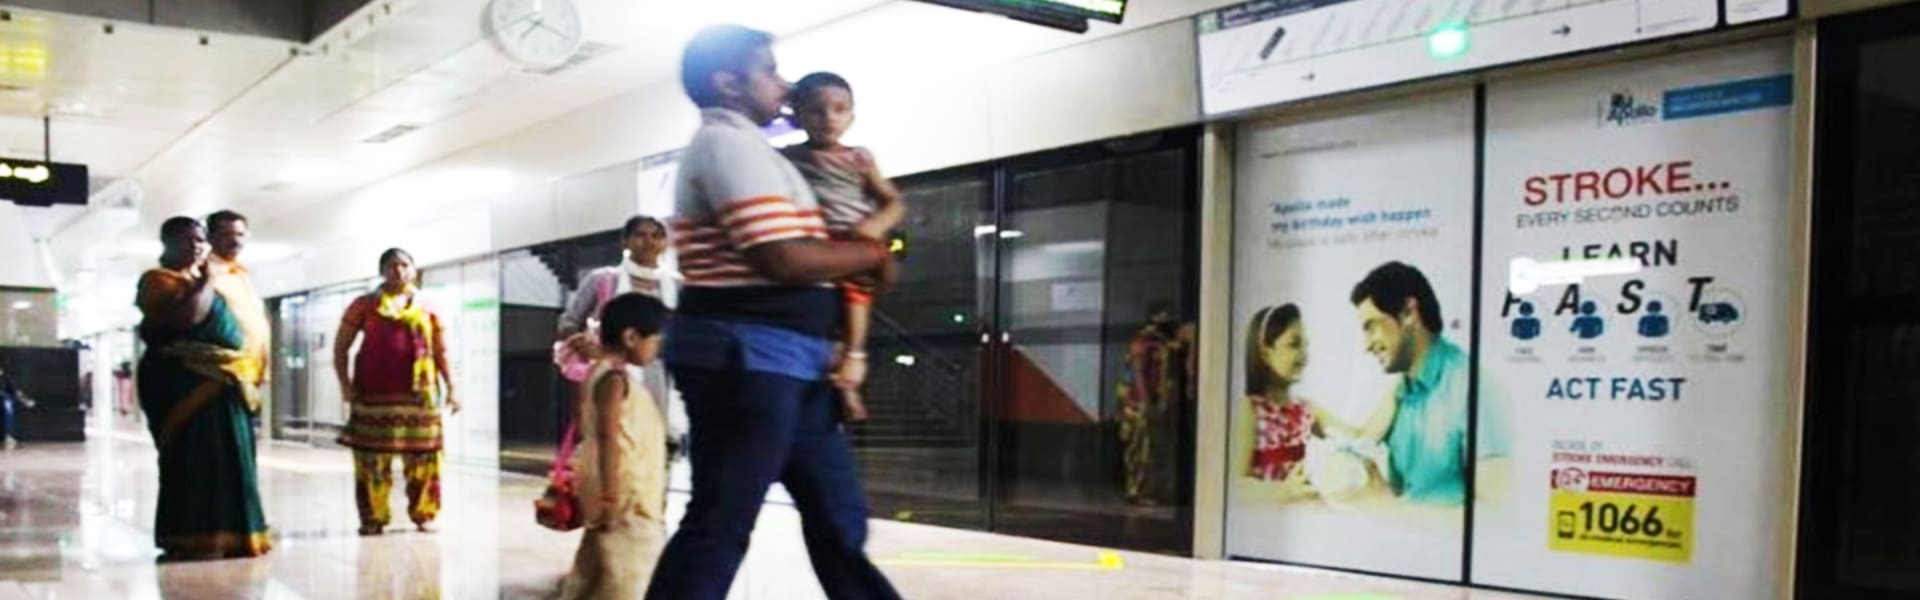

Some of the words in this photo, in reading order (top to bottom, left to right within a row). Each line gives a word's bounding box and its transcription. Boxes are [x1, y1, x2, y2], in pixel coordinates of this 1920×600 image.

[1516, 210, 1568, 229] EVERY
[1574, 203, 1652, 222] SECOND
[1656, 195, 1739, 217] COUNTS
[1546, 377, 1601, 400] ACT
[1611, 377, 1686, 400] FAST
[1590, 474, 1693, 493] EMERGENCY
[1580, 501, 1664, 537] 1066
